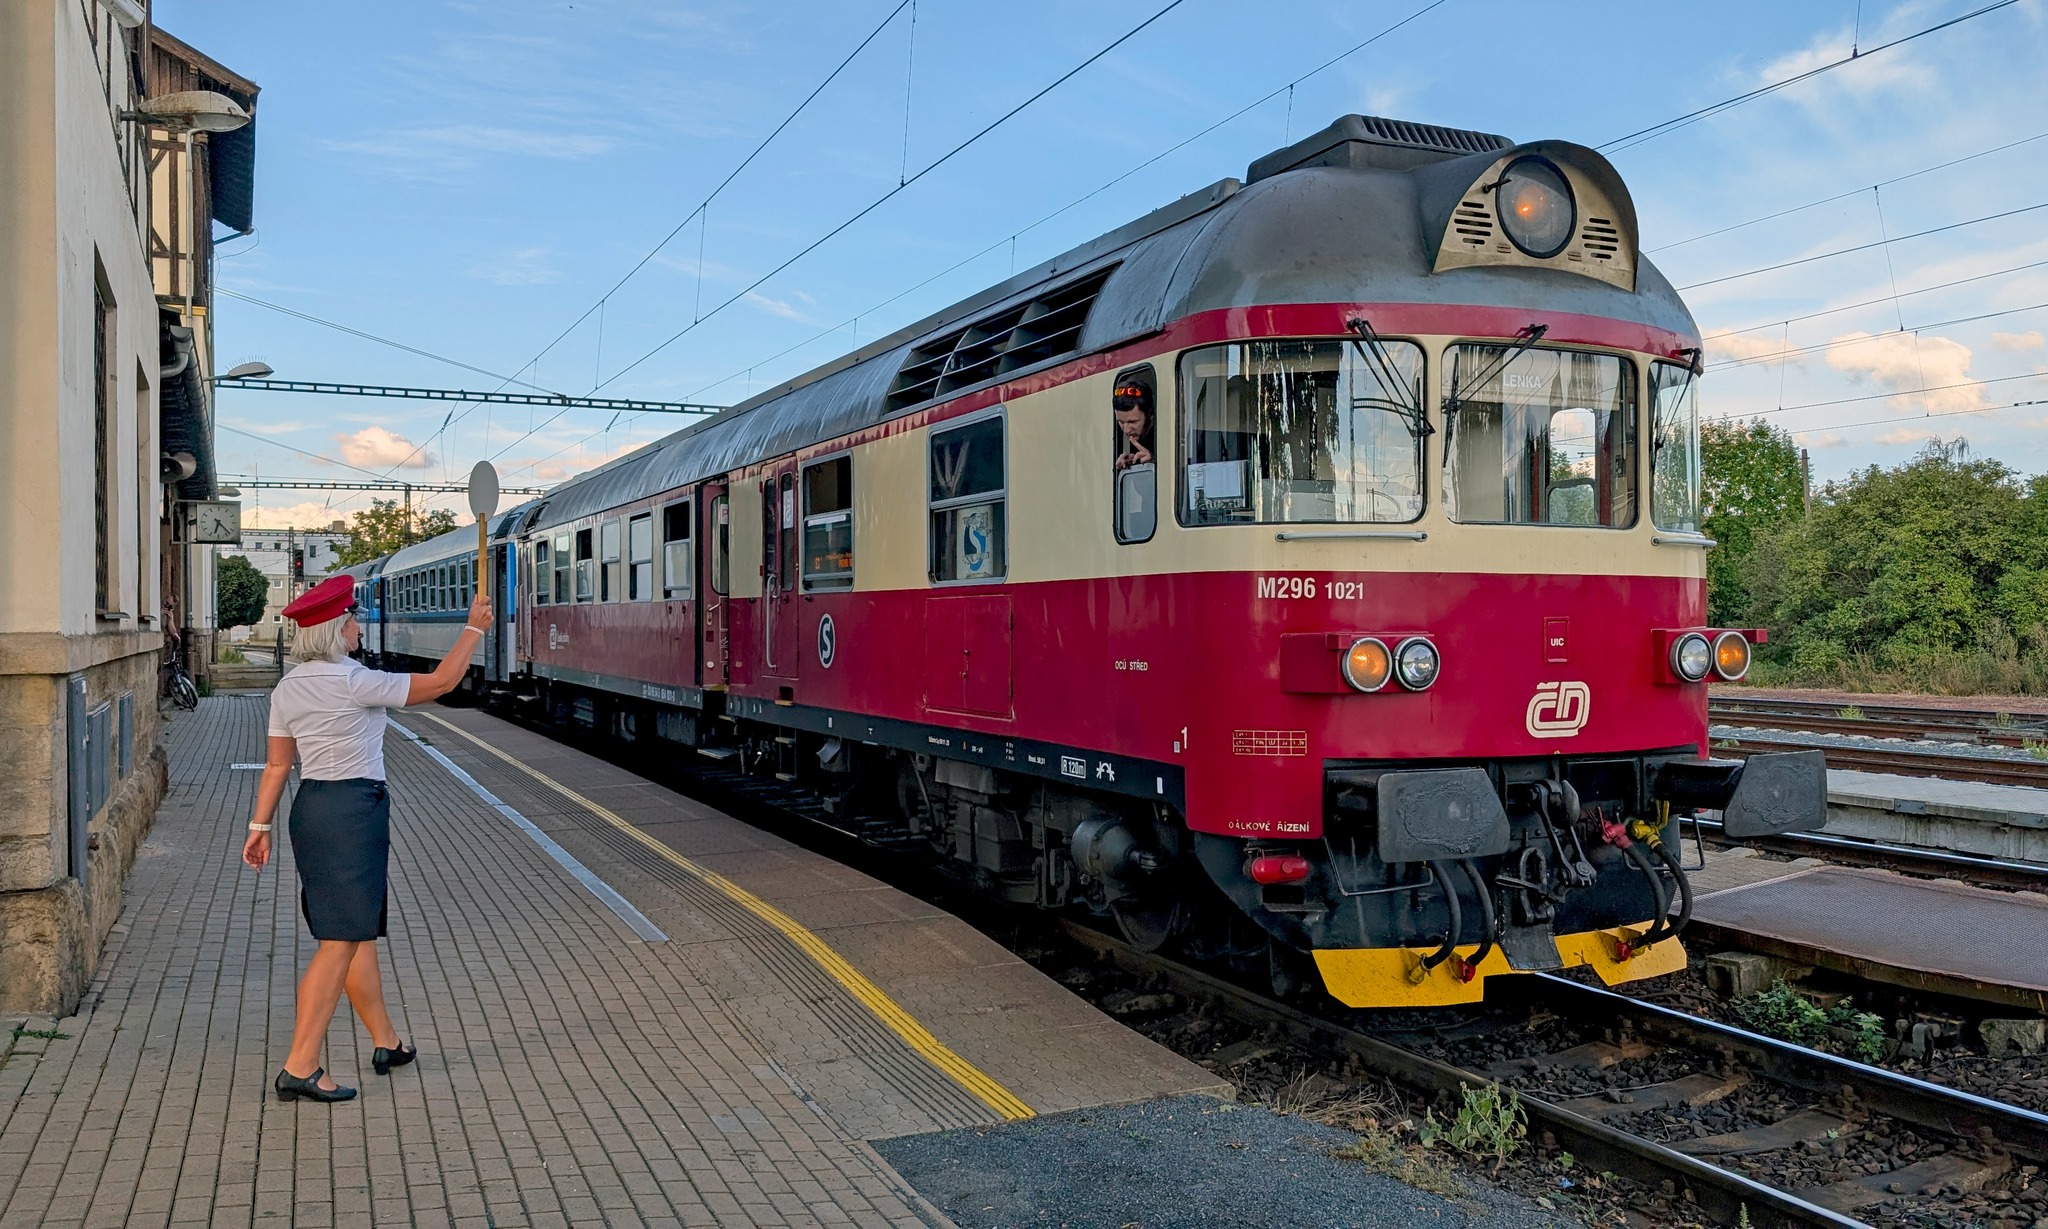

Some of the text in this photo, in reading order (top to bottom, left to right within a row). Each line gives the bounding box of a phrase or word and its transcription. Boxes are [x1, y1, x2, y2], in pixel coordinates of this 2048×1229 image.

[1504, 374, 1542, 388] LENKA
[1257, 576, 1364, 600] M296 1021
[1550, 637, 1565, 647] UIC
[1129, 658, 1149, 671] STŘED
[1181, 726, 1188, 749] 1
[1277, 820, 1310, 833] ŘÍZENÍ
